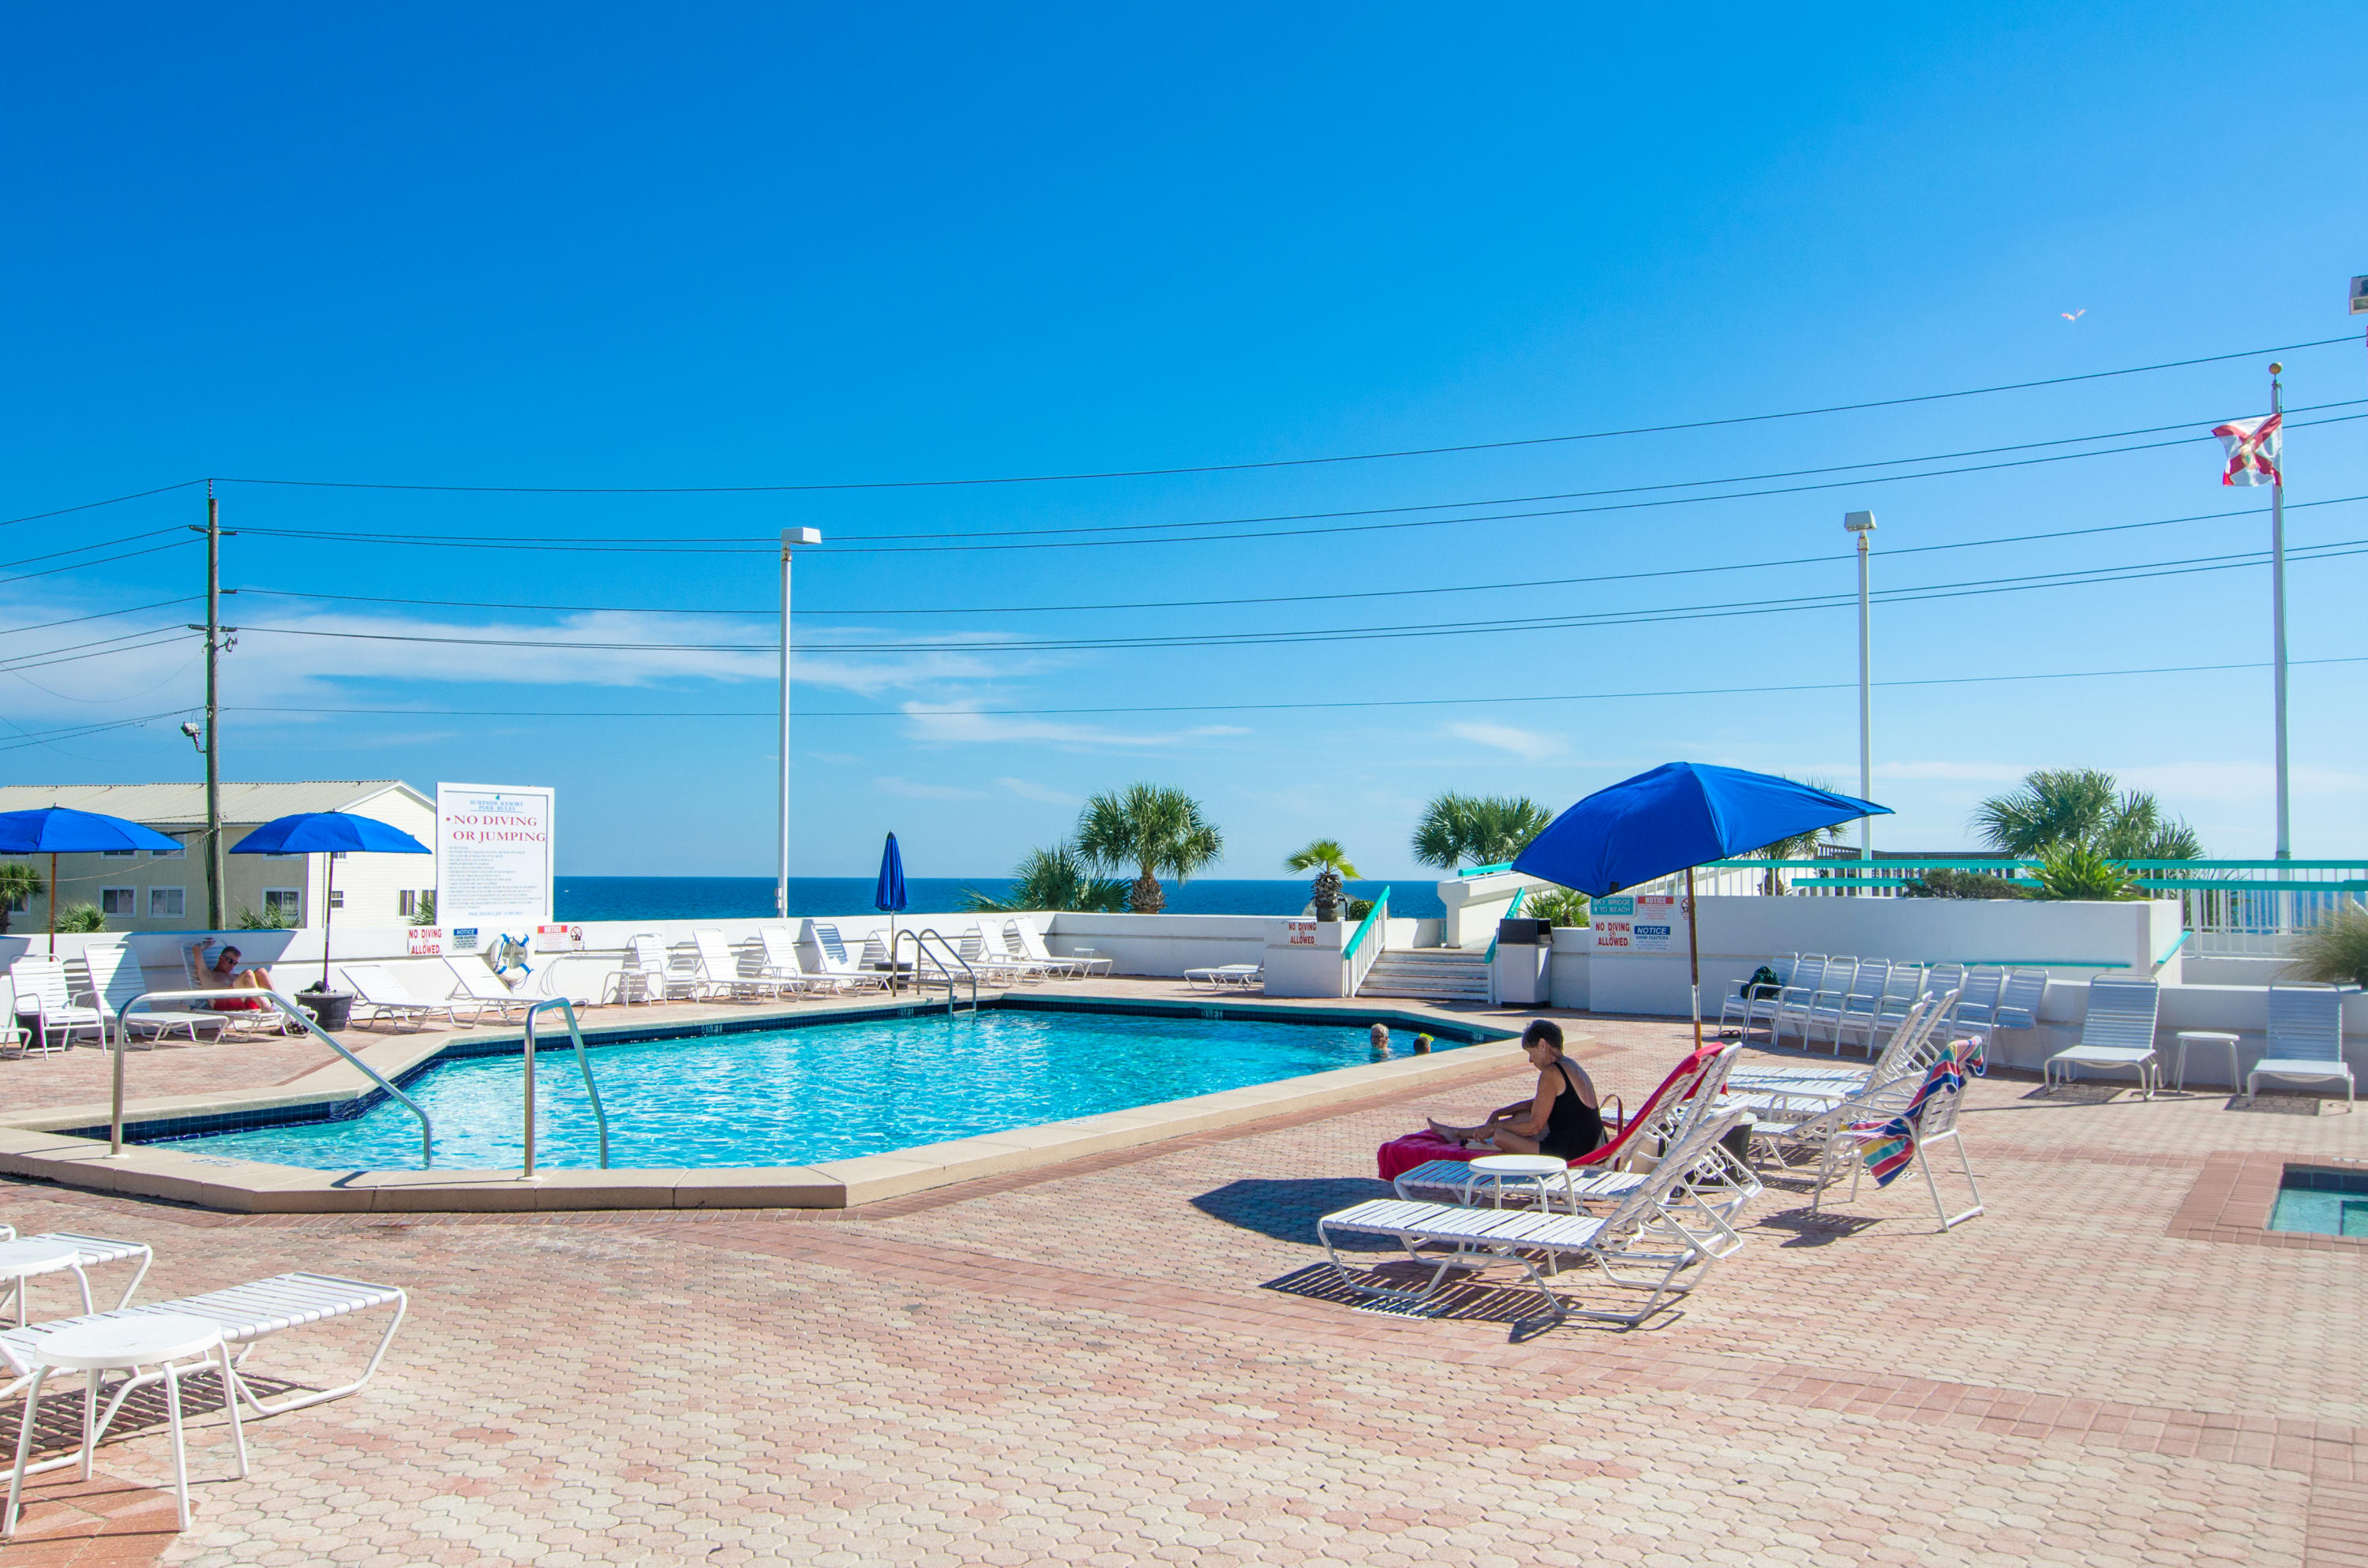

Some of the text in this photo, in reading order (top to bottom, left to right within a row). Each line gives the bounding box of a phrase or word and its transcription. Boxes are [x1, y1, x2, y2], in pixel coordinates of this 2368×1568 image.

[454, 815, 538, 826] NO DIVING
[453, 831, 546, 844] OR JUMPING
[1596, 922, 1630, 931] NO DIVING
[409, 929, 442, 938] NO DIVING
[1598, 937, 1628, 946] ALLOWED
[411, 945, 440, 954] ALLOWED
